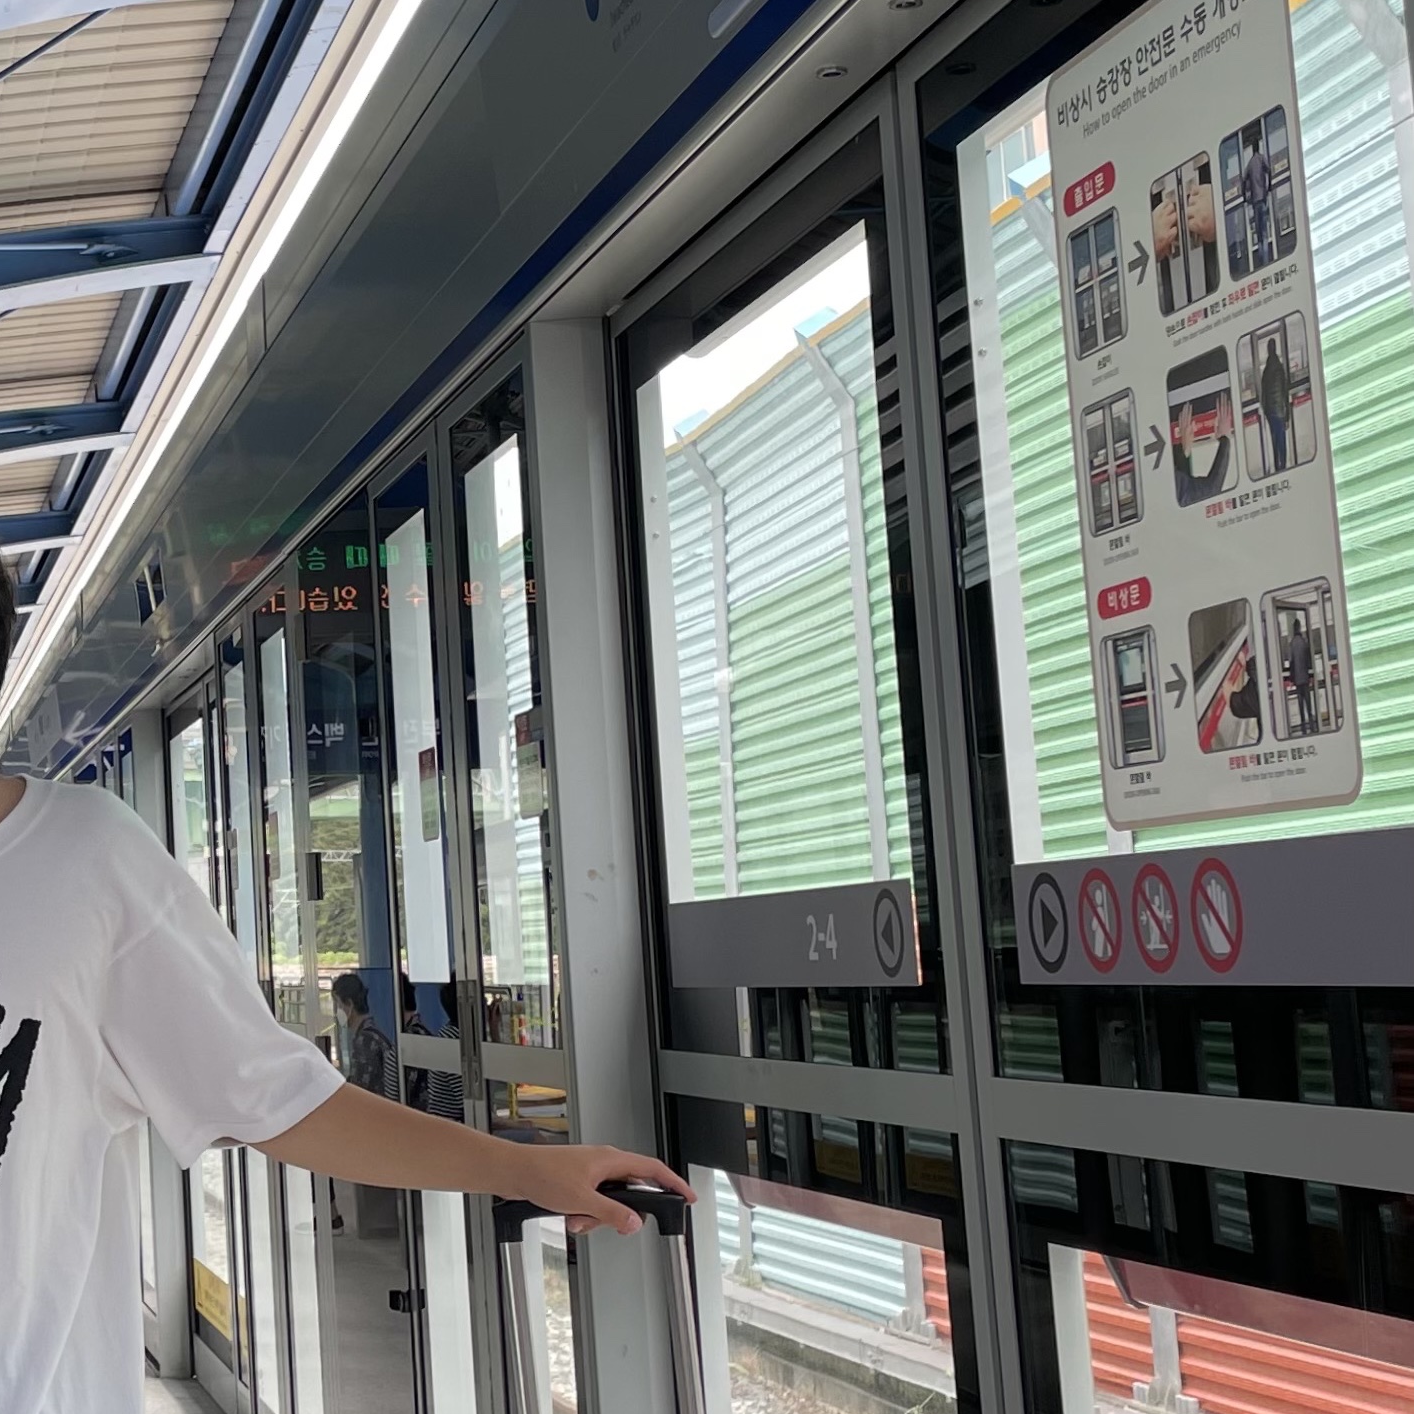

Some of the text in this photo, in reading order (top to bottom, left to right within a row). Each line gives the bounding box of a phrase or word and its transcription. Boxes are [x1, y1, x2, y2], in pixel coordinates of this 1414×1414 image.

[1057, 84, 1092, 128] 비상시
[1096, 56, 1132, 104] 승강장
[1136, 25, 1176, 76] 안전문
[1180, 2, 1207, 43] 수동
[1082, 20, 1242, 138] How to open the door in an emergency
[1107, 583, 1140, 611] 비상문
[806, 913, 838, 961] 2-4
